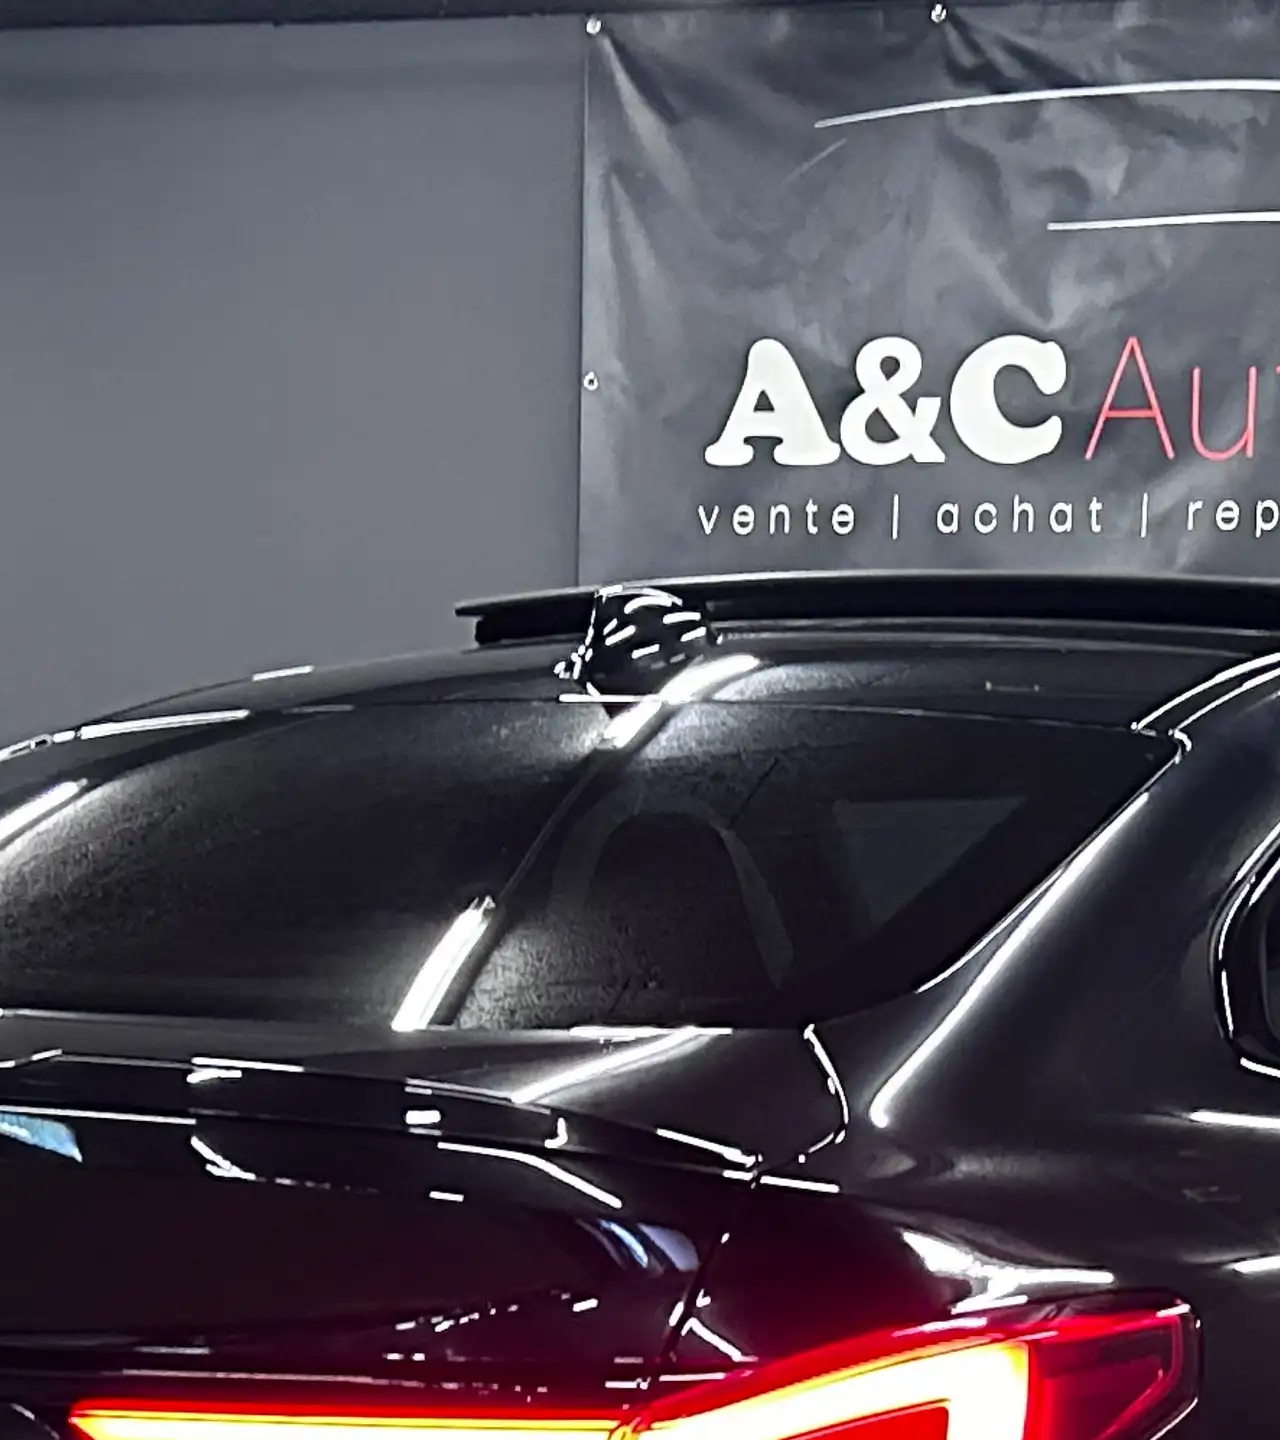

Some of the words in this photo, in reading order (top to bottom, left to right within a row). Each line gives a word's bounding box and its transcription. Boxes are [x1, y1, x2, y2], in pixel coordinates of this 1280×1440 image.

[704, 334, 1068, 466] A&C
[697, 495, 856, 536] vente
[935, 492, 1103, 534] achat
